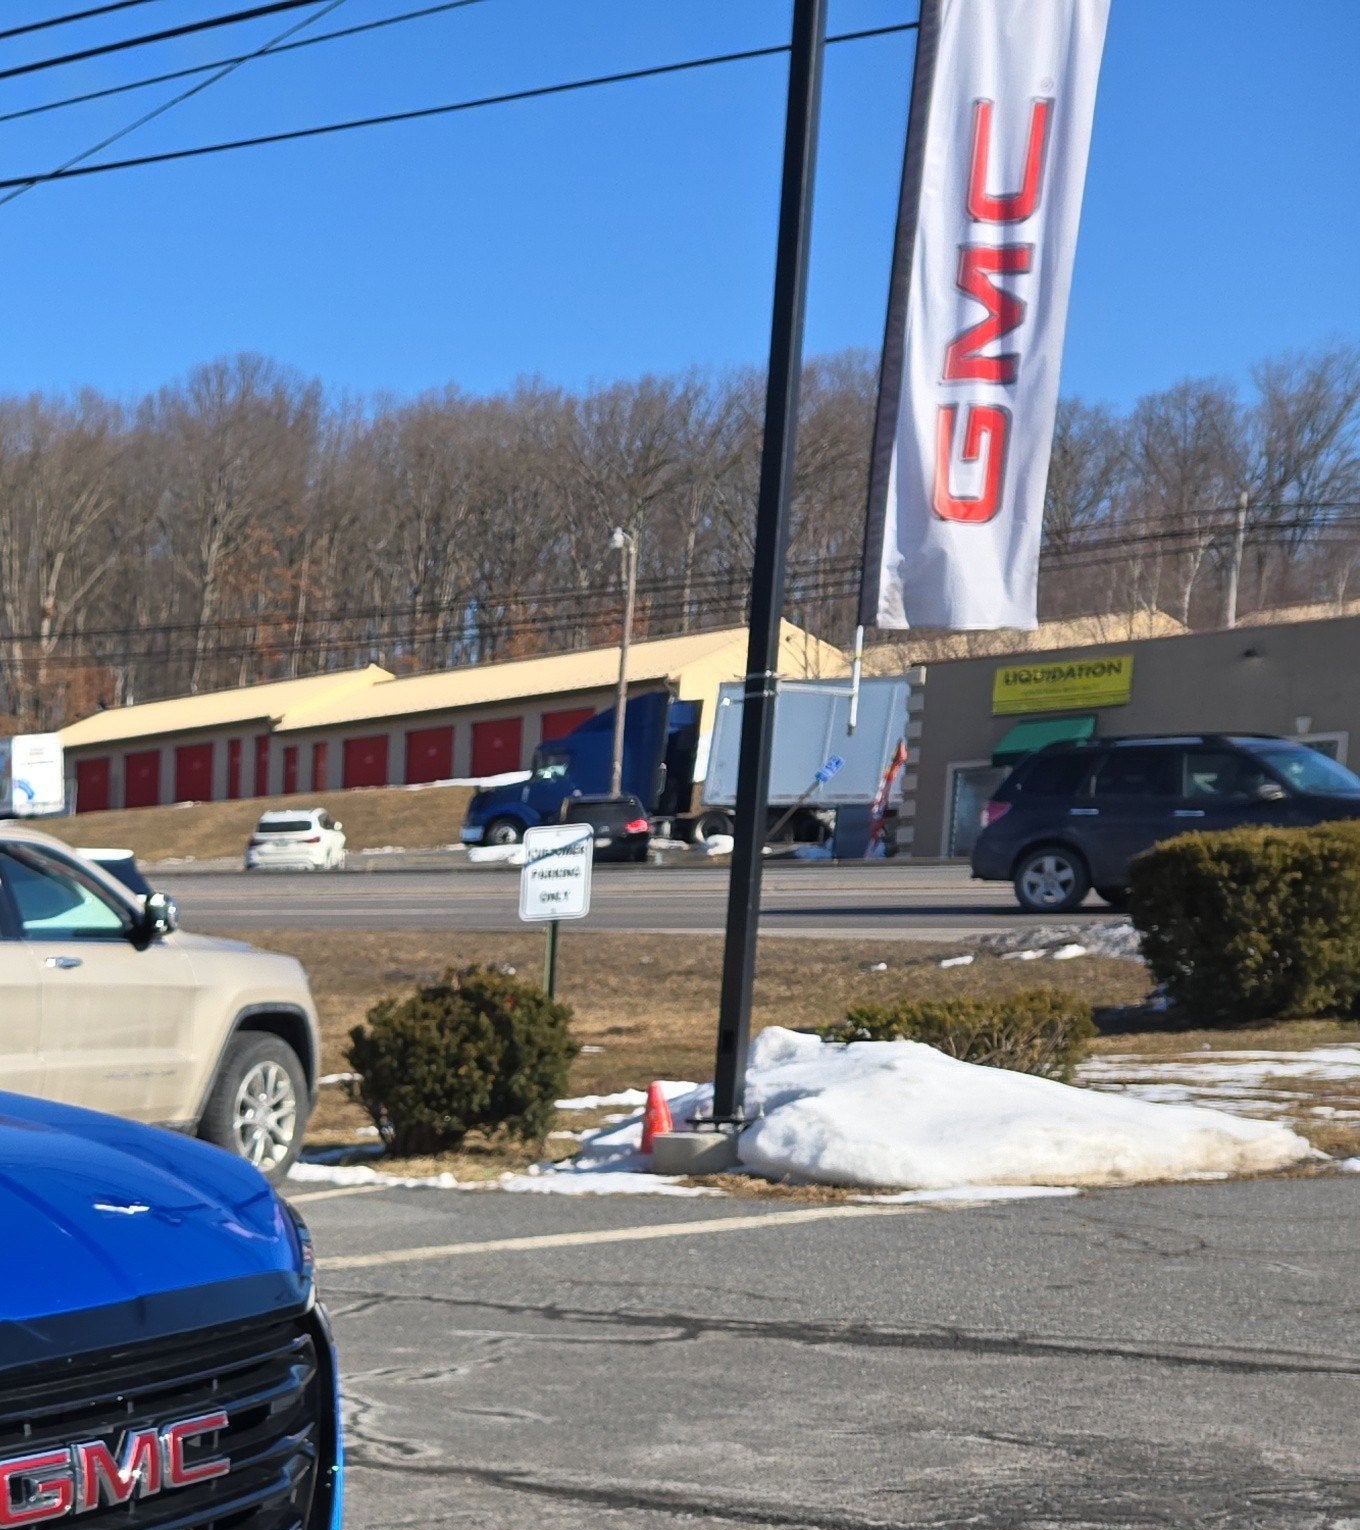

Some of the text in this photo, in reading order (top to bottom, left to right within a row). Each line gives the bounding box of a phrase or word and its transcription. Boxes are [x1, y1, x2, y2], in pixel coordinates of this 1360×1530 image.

[931, 97, 1055, 525] GMC
[1003, 660, 1122, 686] LIQUIDATION
[531, 867, 580, 880] PARKING
[539, 890, 571, 903] ONLY
